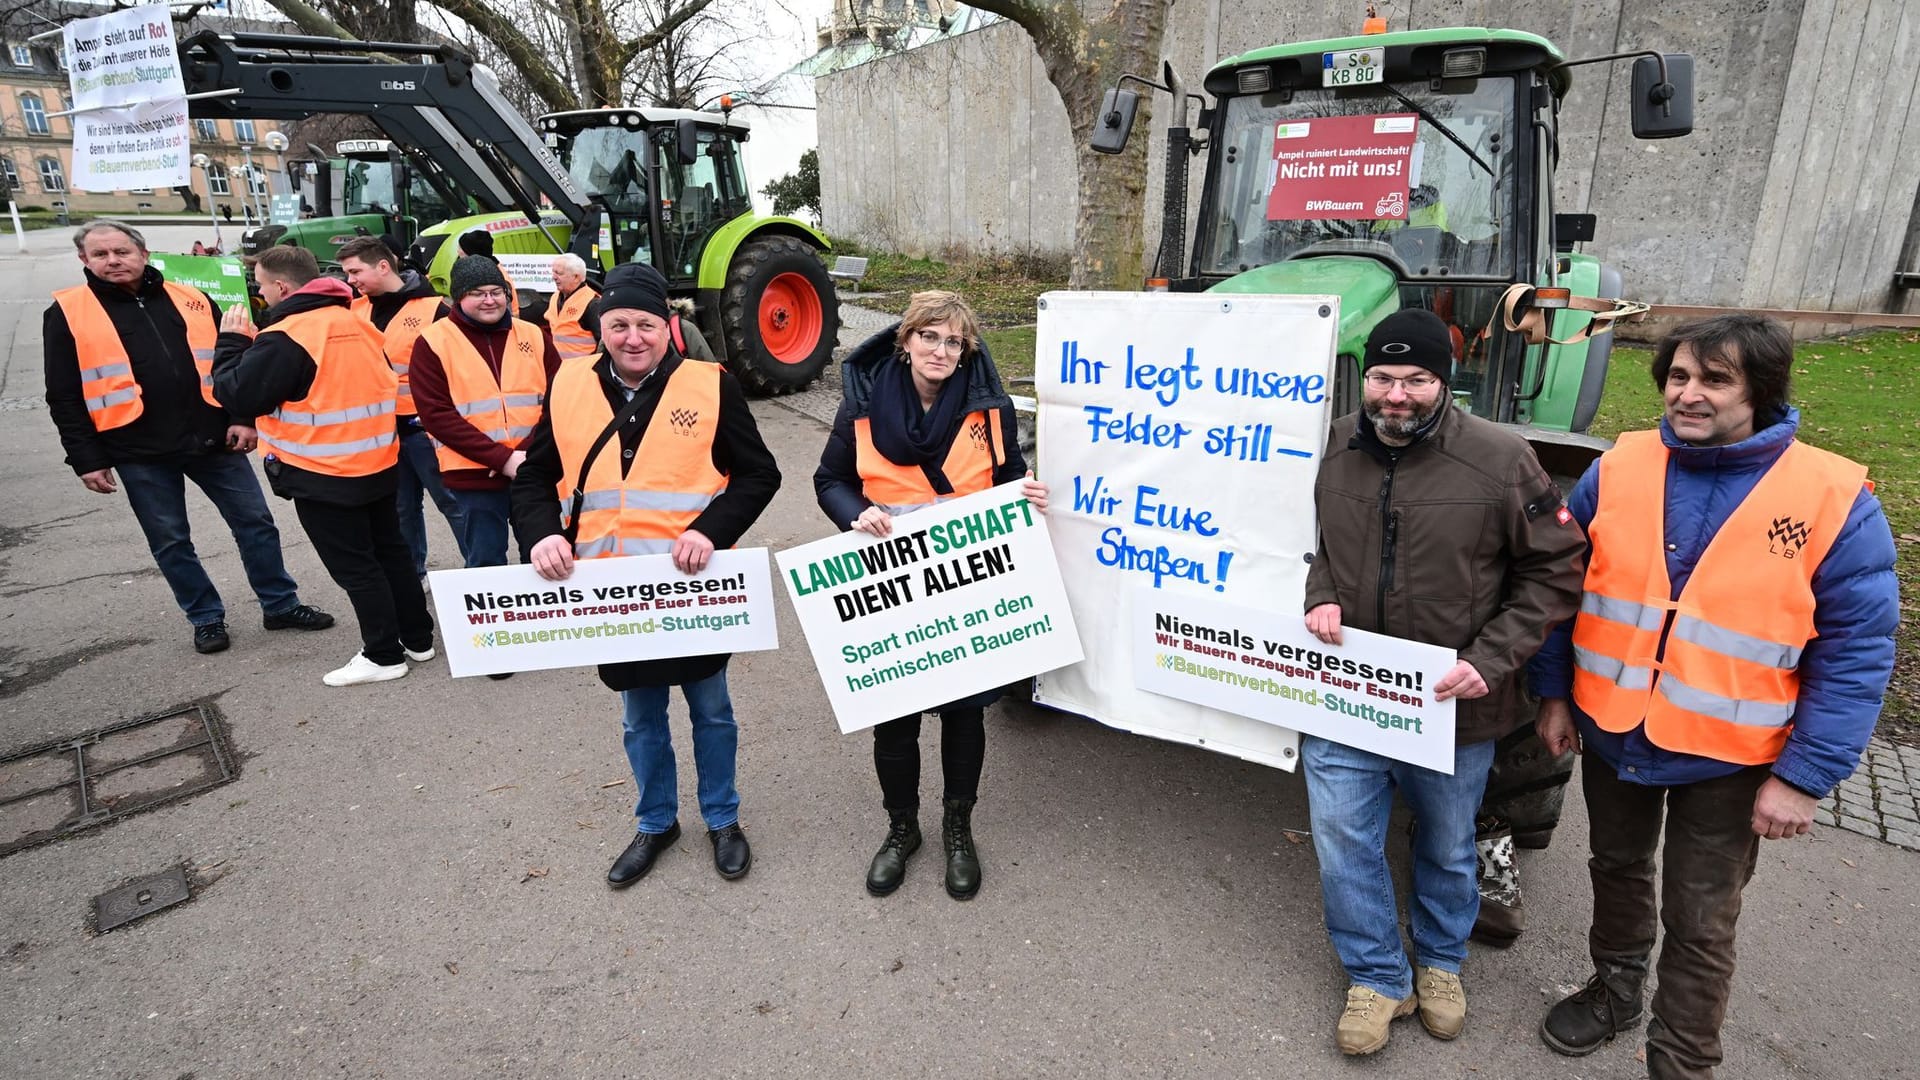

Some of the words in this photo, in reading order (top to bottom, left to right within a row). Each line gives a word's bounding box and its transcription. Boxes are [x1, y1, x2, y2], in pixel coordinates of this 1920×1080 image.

[104, 28, 127, 46] steht
[129, 24, 145, 40] auf
[148, 21, 167, 40] Rot
[78, 57, 92, 72] die
[93, 51, 119, 69] Zunft
[120, 49, 147, 63] unserer
[149, 43, 171, 59] Höfe
[1348, 53, 1358, 67] S
[79, 63, 176, 92] Berband-Stuttgart
[1332, 69, 1350, 84] KB
[1356, 67, 1374, 82] 80
[86, 124, 97, 137] Wir
[98, 123, 111, 136] sind
[111, 122, 124, 134] hier
[89, 142, 105, 155] denn
[106, 142, 116, 154] wir
[117, 140, 135, 153] finden
[137, 139, 149, 152] Eure
[150, 135, 165, 151] Politik
[166, 137, 172, 148] so
[1277, 150, 1304, 160] Ampel
[1306, 148, 1337, 158] ruiniert
[1339, 146, 1410, 157] Landwirtschaft!
[1280, 161, 1325, 179] Nicht
[1329, 160, 1358, 177] mit
[1363, 160, 1403, 177] uns!
[1305, 200, 1364, 211] BWBauern
[485, 218, 529, 232] CLAAS
[1060, 341, 1112, 385] Ihr
[1125, 345, 1203, 407] legt
[1215, 367, 1324, 404] unsere
[1084, 405, 1192, 449] Felder
[1204, 423, 1273, 462] still
[1073, 475, 1122, 515] Wir
[1133, 485, 1219, 537] Eure
[790, 498, 1034, 596] LANDWIRTSCHAFT
[1096, 527, 1234, 593] Straßen!
[1769, 544, 1798, 559] LB
[464, 586, 584, 611] Niemals
[592, 573, 746, 602] vergessen!
[833, 574, 914, 623] DIENT
[923, 543, 1016, 597] ALLEN!
[467, 611, 499, 625] Wir
[504, 607, 567, 623] Bauern
[572, 602, 650, 618] erzeugen
[655, 595, 693, 610] Euer
[698, 593, 748, 606] Essen
[495, 611, 751, 647] Bauernverband-Stuttgart
[842, 632, 902, 664] Spart
[904, 614, 959, 647] nicht
[962, 607, 989, 627] an
[994, 594, 1034, 619] den
[846, 643, 967, 693] heimischen
[970, 614, 1053, 655] Bauern!
[1155, 613, 1255, 650] Niemals
[1263, 640, 1423, 691] vergessen!
[1155, 633, 1179, 648] Wir
[1183, 640, 1237, 662] Bauern
[1241, 654, 1315, 680] erzeugen
[1320, 671, 1361, 691] Euer
[1365, 684, 1423, 708] Essen
[1172, 656, 1423, 734] Bauernverband-Stuttgart
